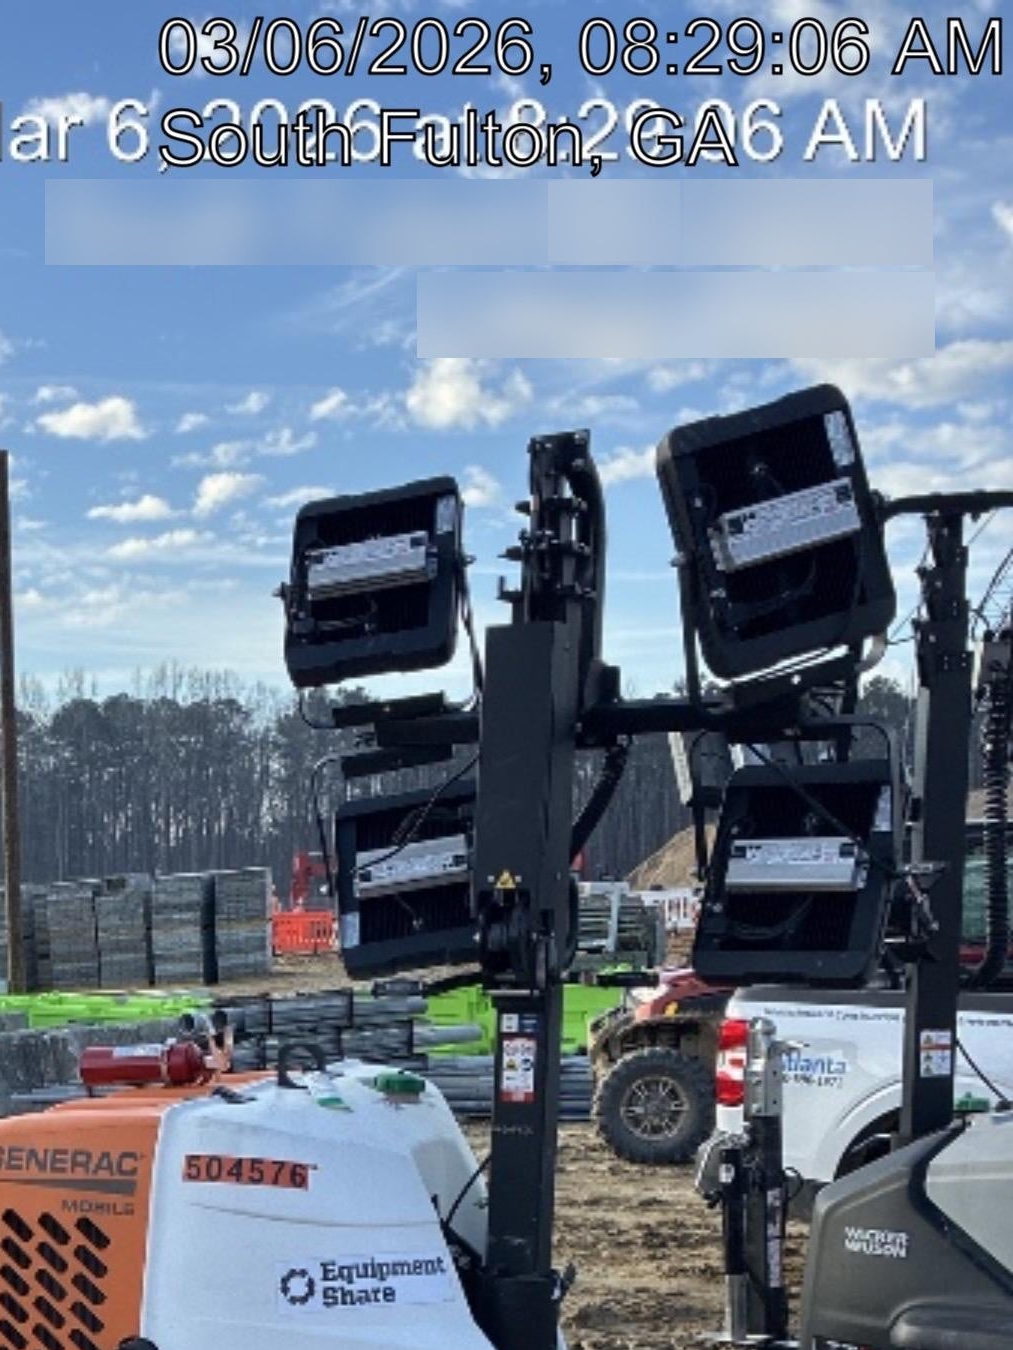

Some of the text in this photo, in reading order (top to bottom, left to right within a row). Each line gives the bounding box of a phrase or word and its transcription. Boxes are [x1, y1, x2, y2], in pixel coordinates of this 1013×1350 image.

[185, 1154, 308, 1189] 504576
[320, 1256, 447, 1285] Equipment
[323, 1285, 397, 1308] Share
